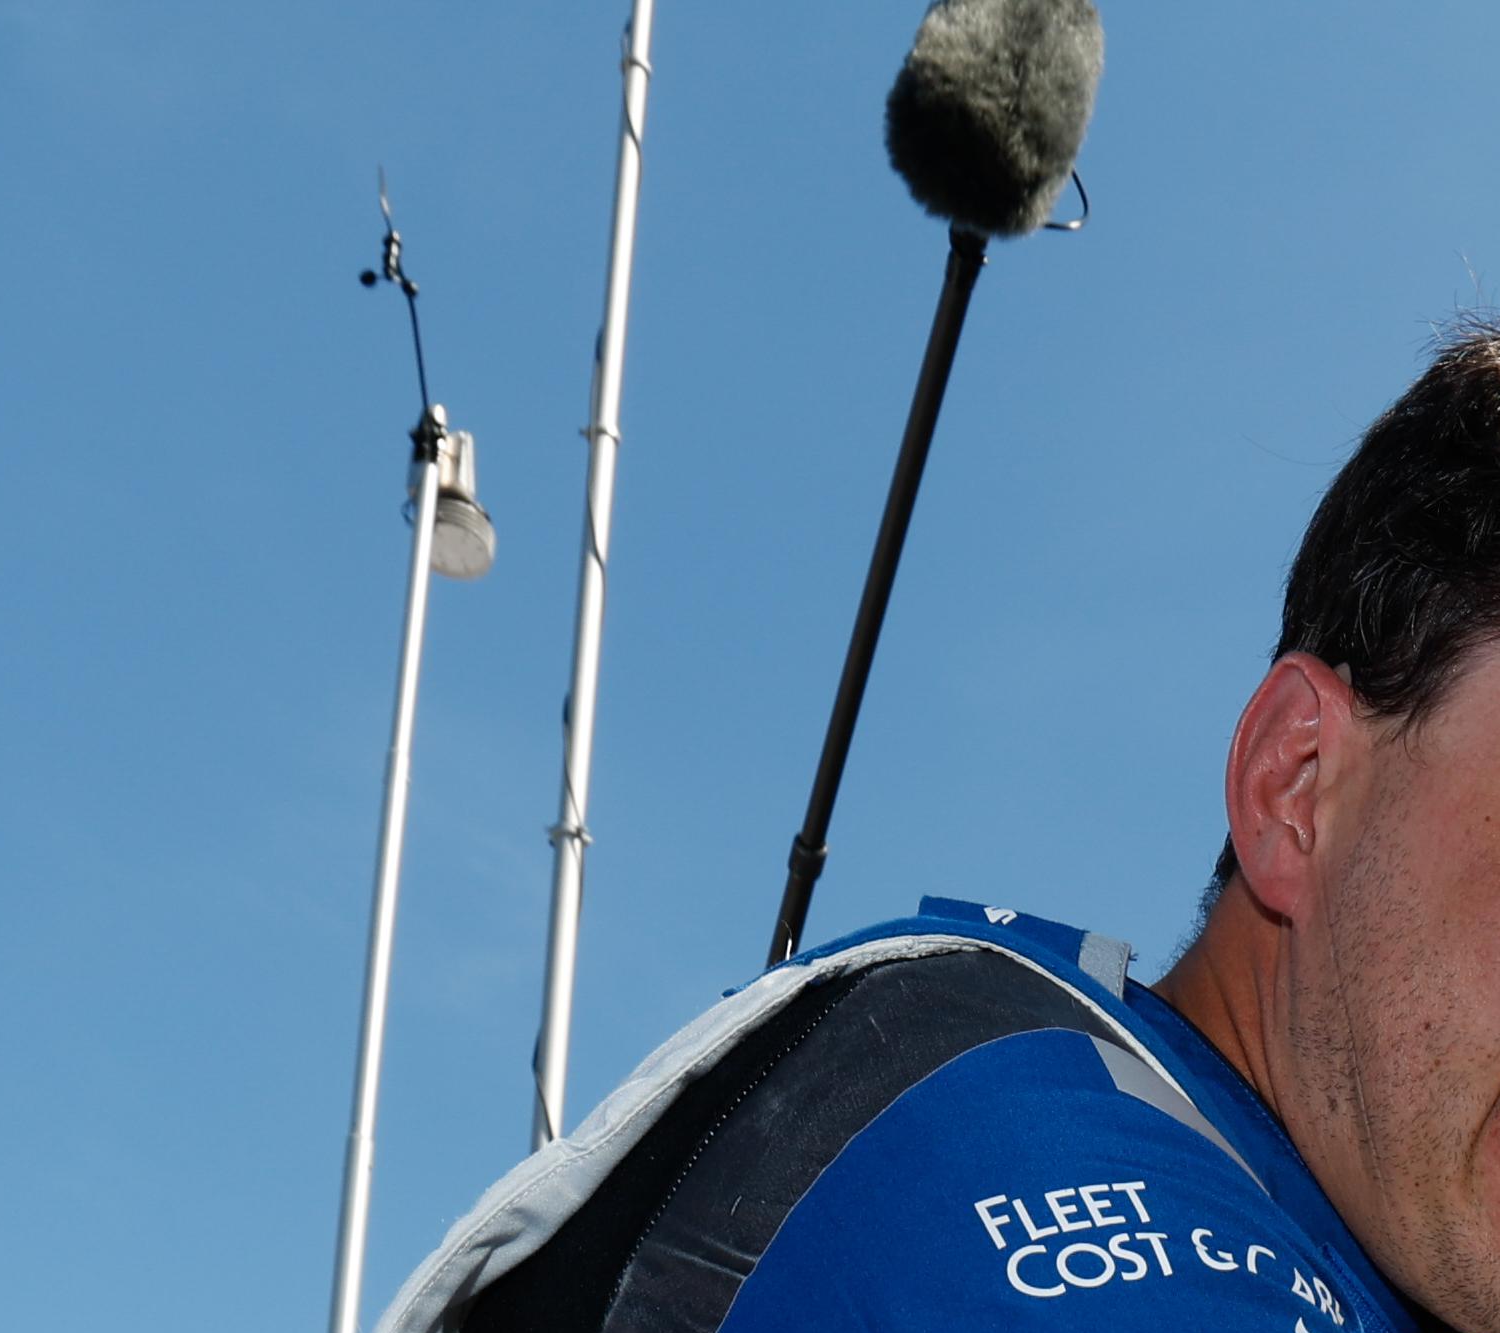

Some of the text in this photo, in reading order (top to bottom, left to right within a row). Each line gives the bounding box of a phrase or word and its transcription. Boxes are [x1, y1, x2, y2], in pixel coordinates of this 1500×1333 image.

[974, 1180, 1151, 1250] FLEET
[1006, 1232, 1173, 1297] COST
[1191, 1228, 1240, 1271] &
